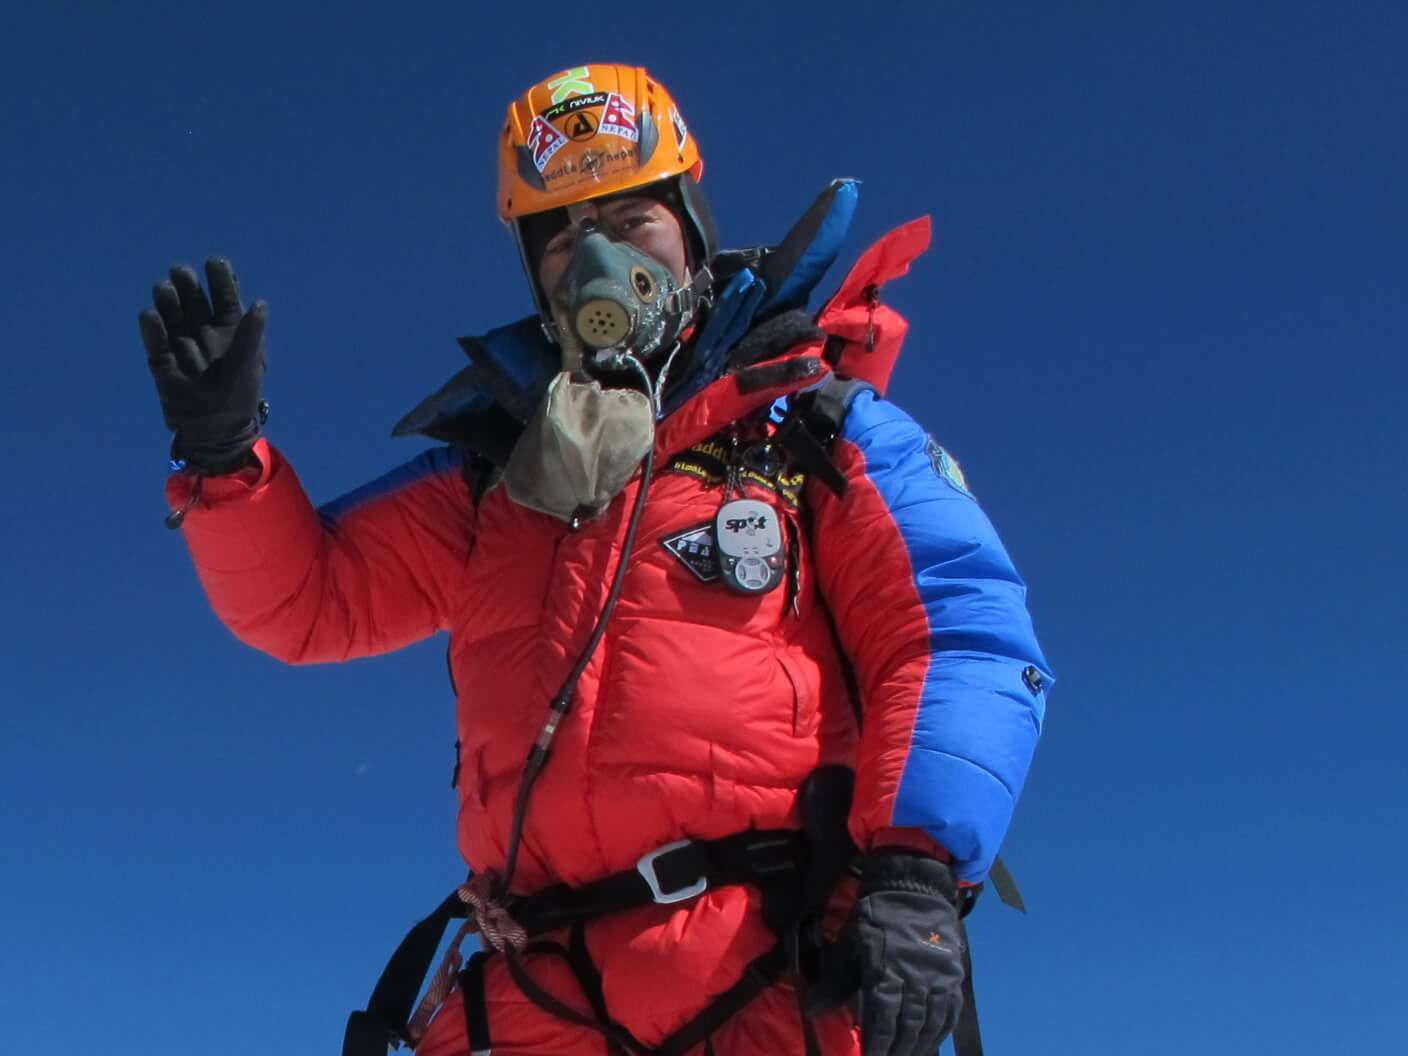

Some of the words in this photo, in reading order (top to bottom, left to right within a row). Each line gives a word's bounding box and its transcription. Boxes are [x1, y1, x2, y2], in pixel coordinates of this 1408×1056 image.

[601, 124, 638, 141] NEPAL
[537, 137, 566, 167] NEPAL
[675, 539, 711, 558] PEA
